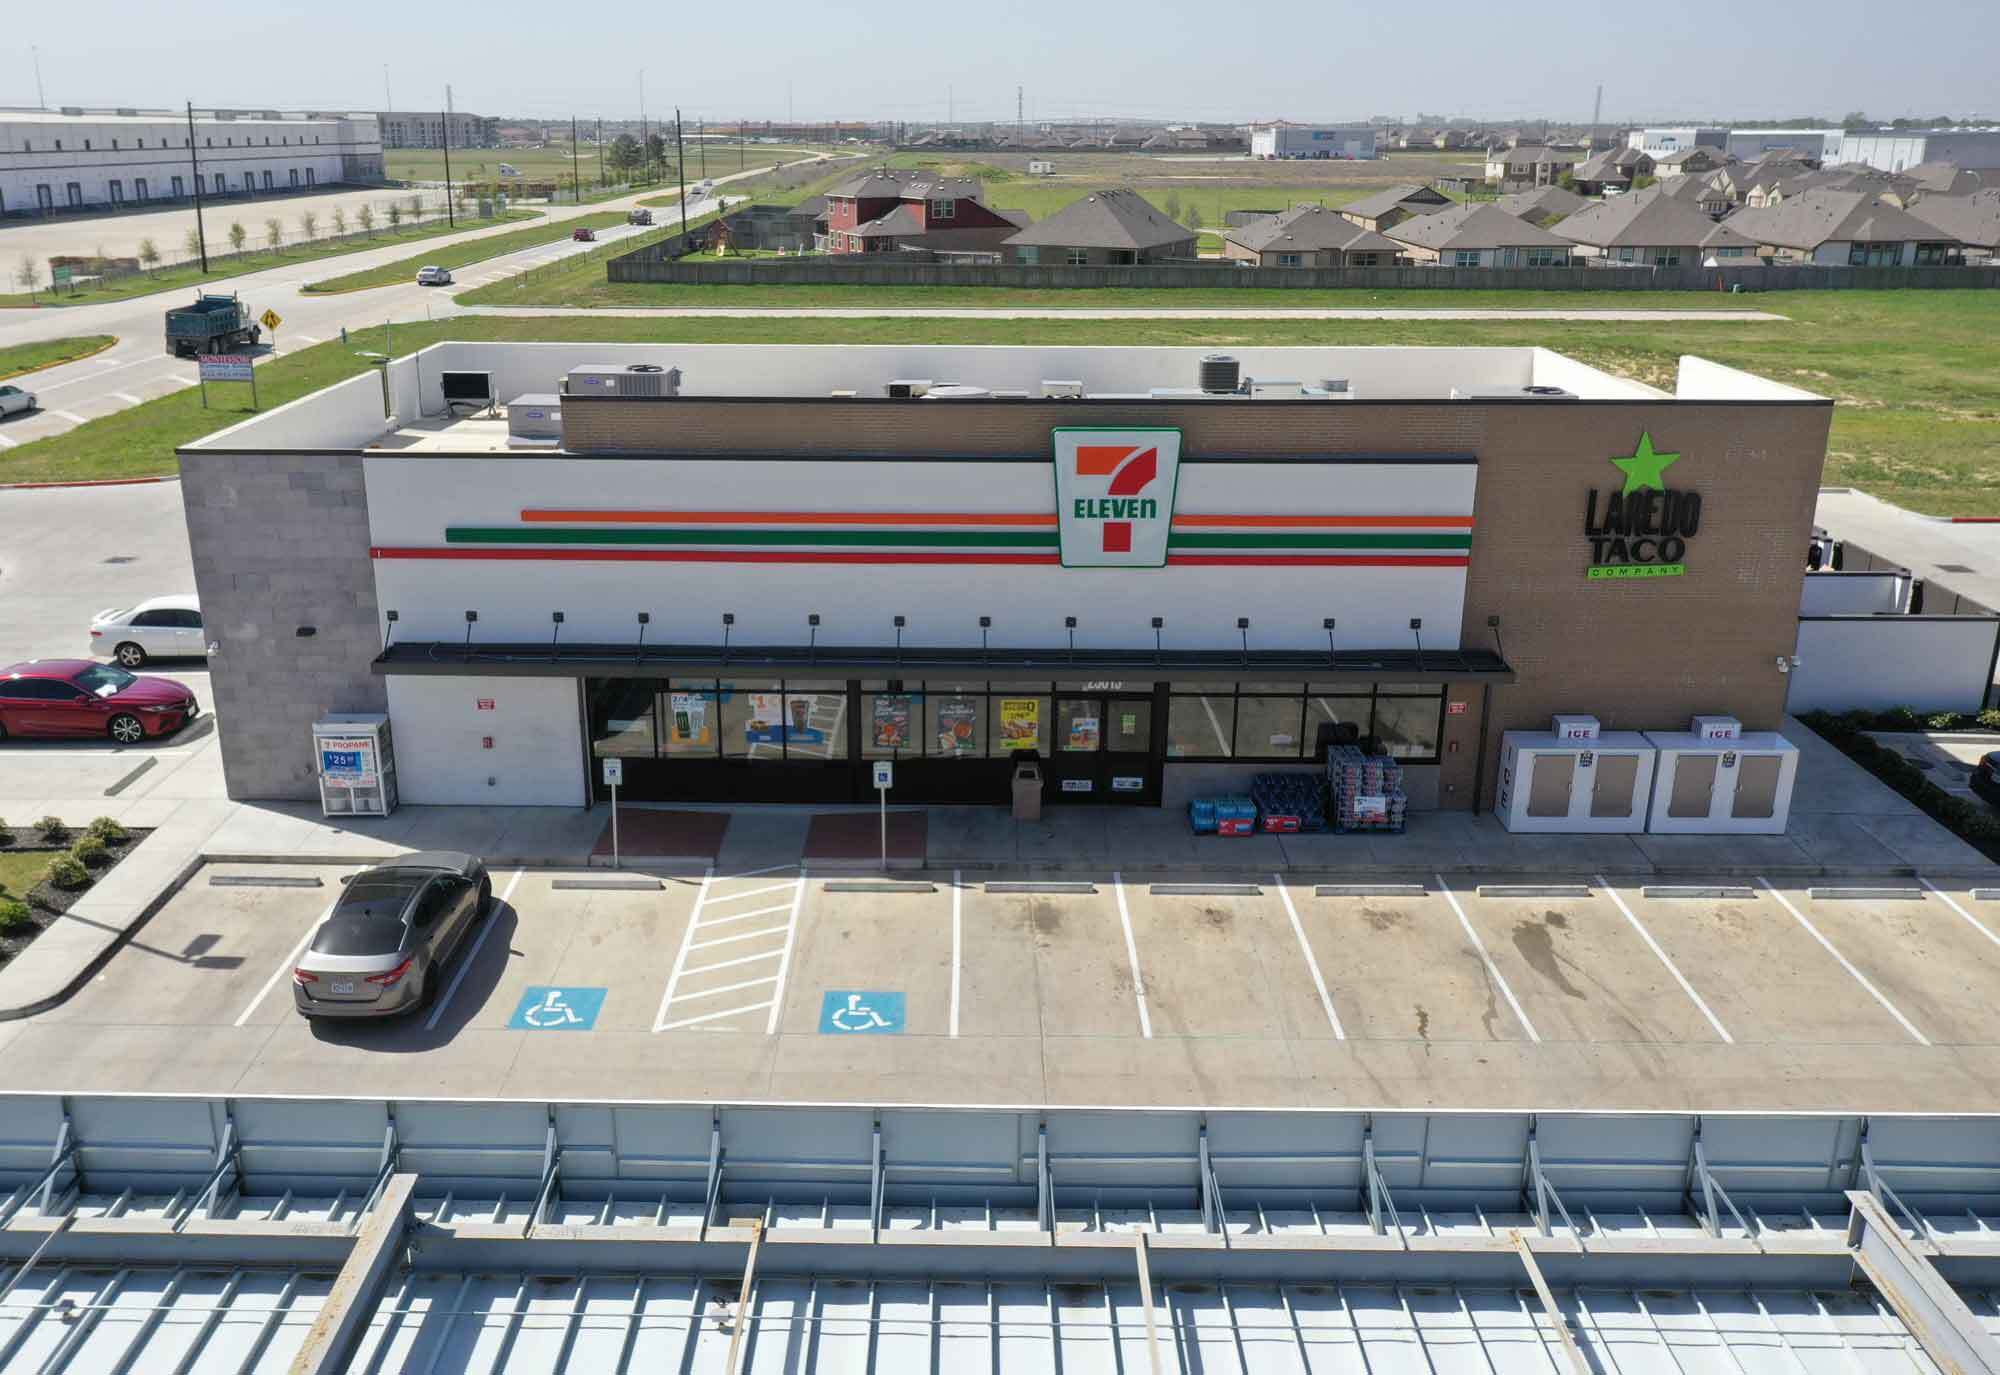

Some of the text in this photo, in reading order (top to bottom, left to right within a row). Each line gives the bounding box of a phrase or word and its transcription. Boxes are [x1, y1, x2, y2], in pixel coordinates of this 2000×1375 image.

[1076, 446, 1158, 553] 7
[1584, 488, 1702, 538] LAREDO
[1589, 537, 1686, 564] TACO
[1592, 566, 1680, 577] COMPANY
[1568, 730, 1592, 738] ICE
[1710, 730, 1733, 739] ICE
